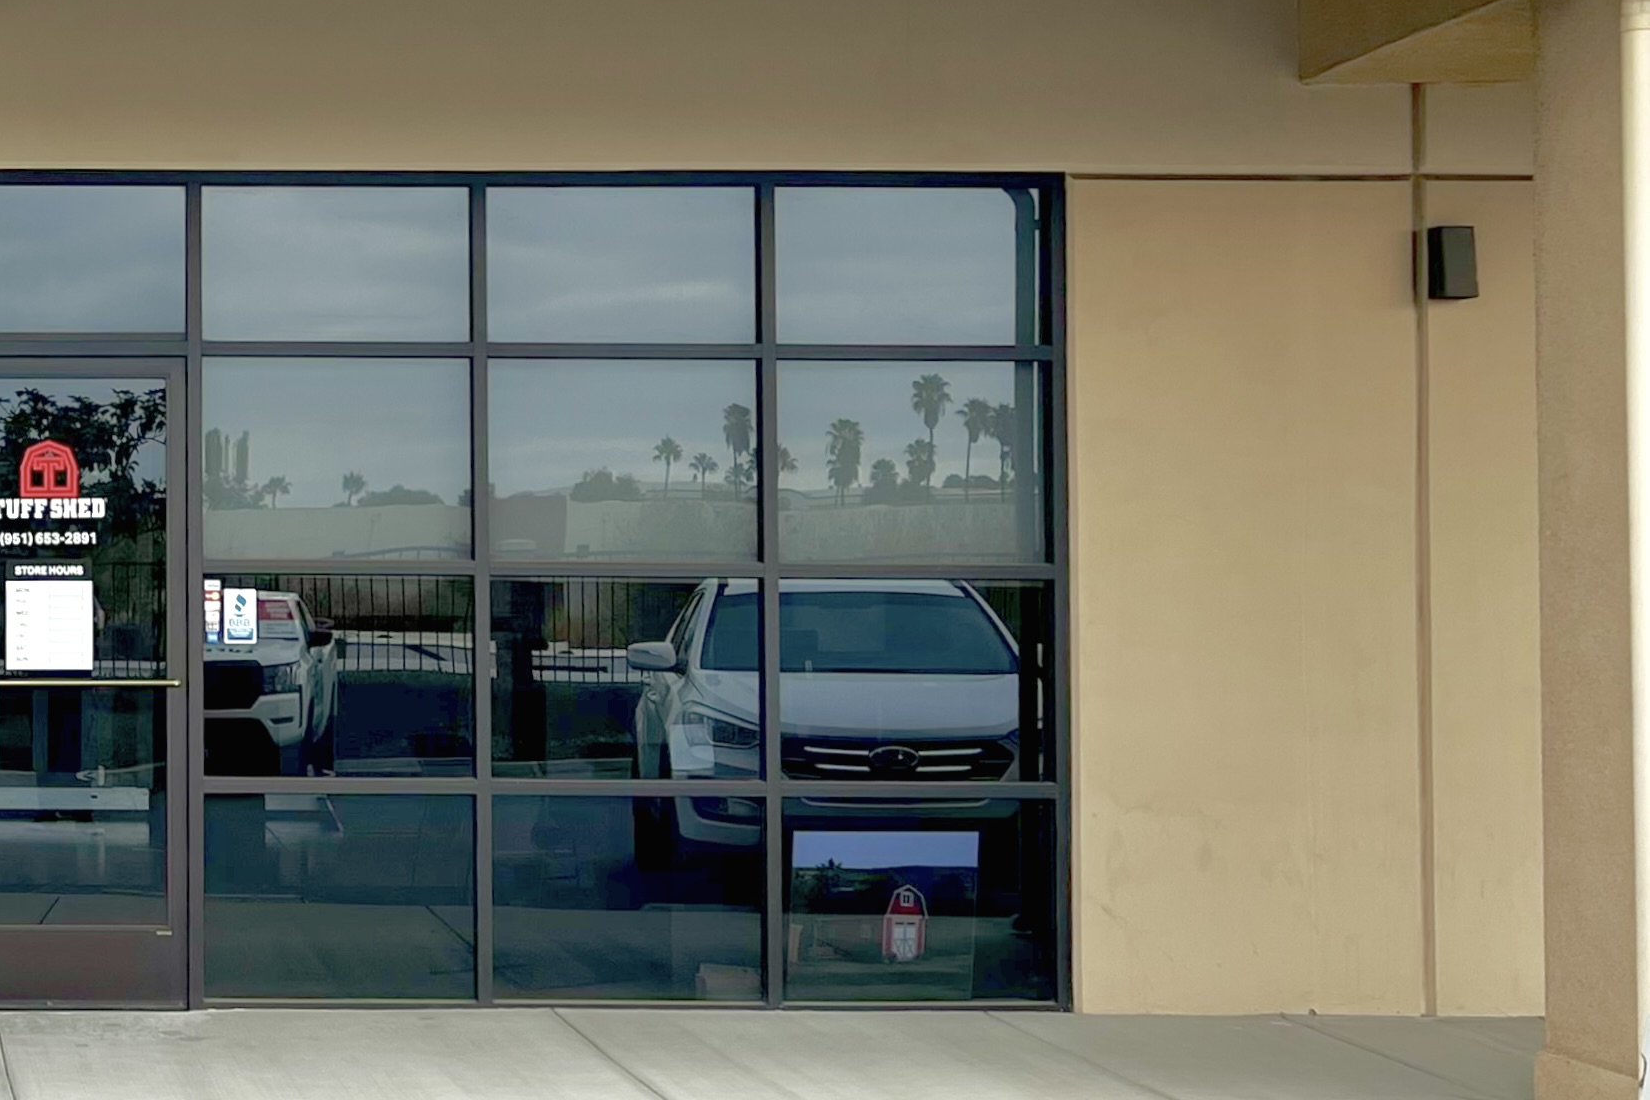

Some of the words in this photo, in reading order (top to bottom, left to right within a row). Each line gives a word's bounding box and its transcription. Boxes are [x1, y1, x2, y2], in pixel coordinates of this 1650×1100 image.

[49, 497, 107, 520] SHED
[0, 531, 33, 547] (951)
[34, 531, 97, 546] 653-2891
[14, 564, 47, 576] STORE
[48, 564, 84, 576] HOURS
